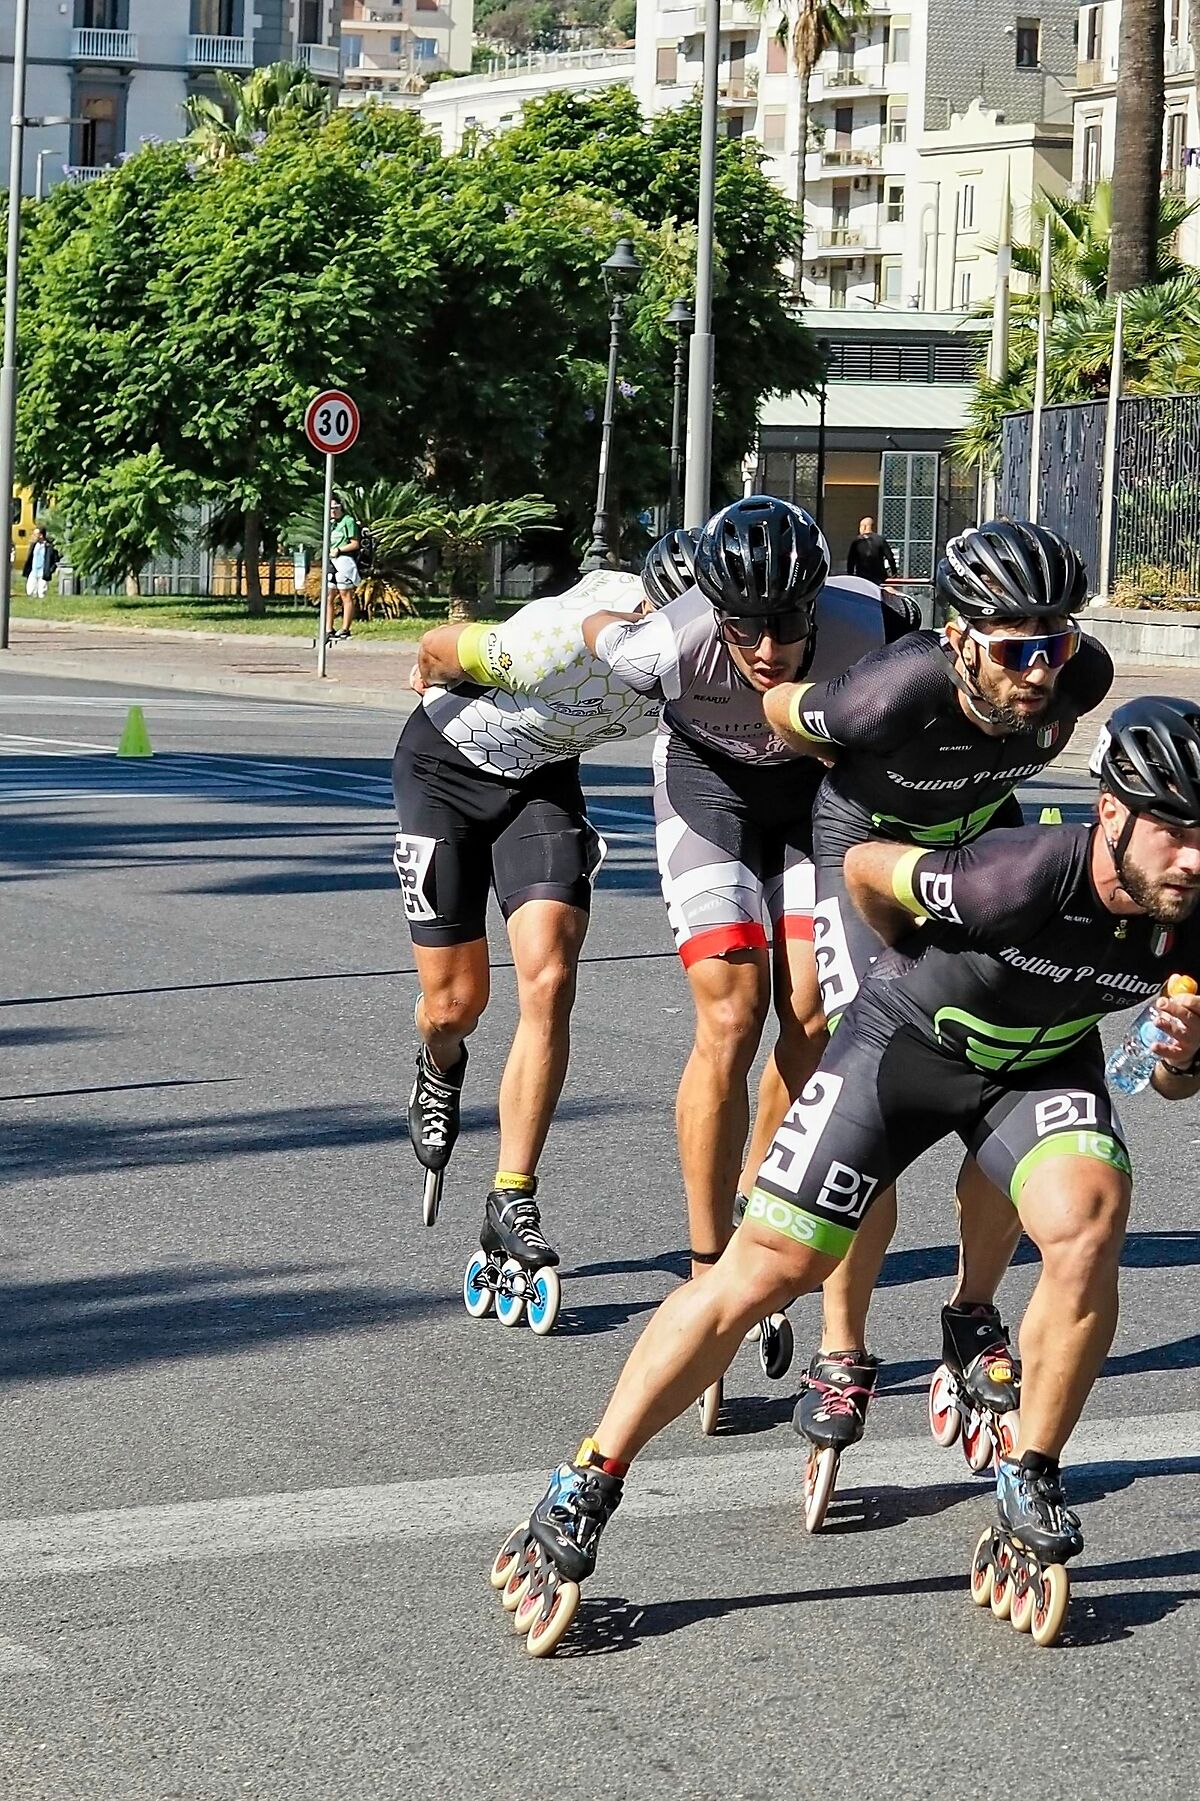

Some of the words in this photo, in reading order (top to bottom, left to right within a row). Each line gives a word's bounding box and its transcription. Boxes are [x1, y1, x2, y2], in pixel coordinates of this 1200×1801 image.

[319, 409, 349, 437] 30
[886, 770, 969, 791] Rolling
[998, 946, 1073, 983] Rolling
[748, 1194, 817, 1240] BOS
